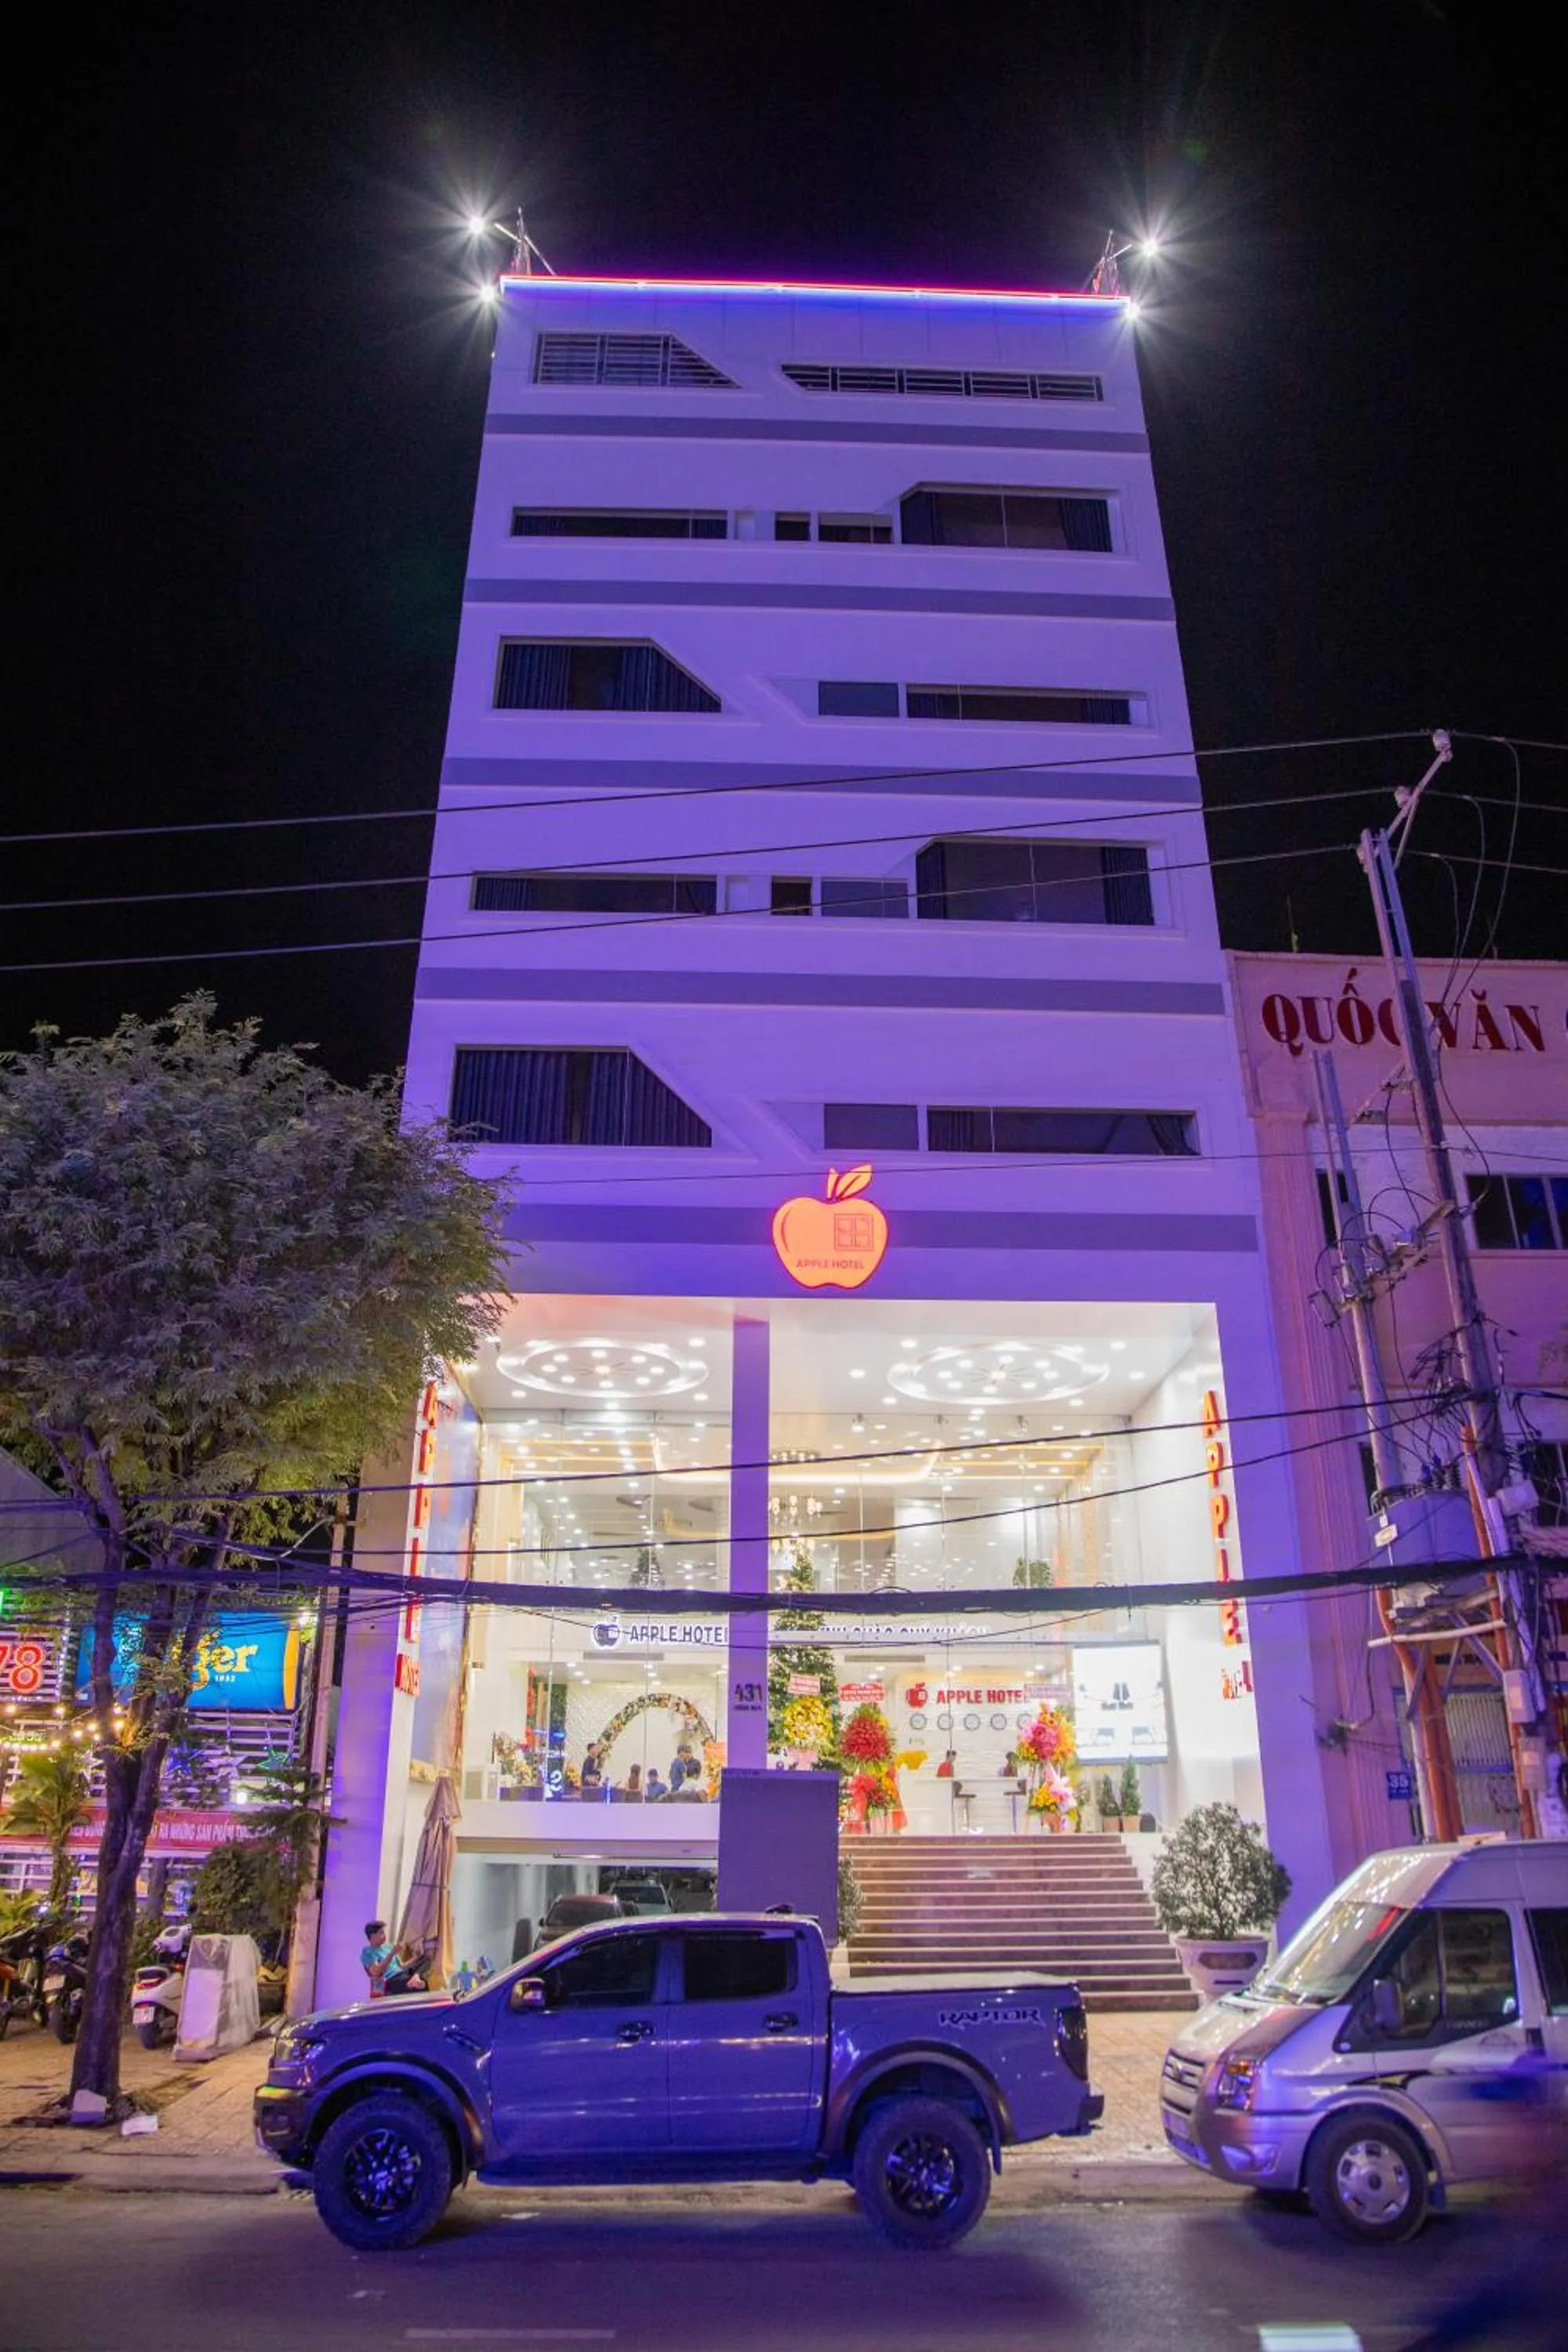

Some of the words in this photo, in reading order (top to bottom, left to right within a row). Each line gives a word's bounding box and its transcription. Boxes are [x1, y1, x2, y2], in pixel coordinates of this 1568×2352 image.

[1425, 989, 1545, 1052] VĂN
[796, 1258, 829, 1269] APPLE
[831, 1259, 864, 1269] HOTEL
[630, 1625, 678, 1642] APPLE
[683, 1625, 728, 1643] HOTE
[734, 1683, 763, 1702] 431
[936, 1690, 982, 1704] APPLE
[939, 2007, 1045, 2029] RAPTOR
